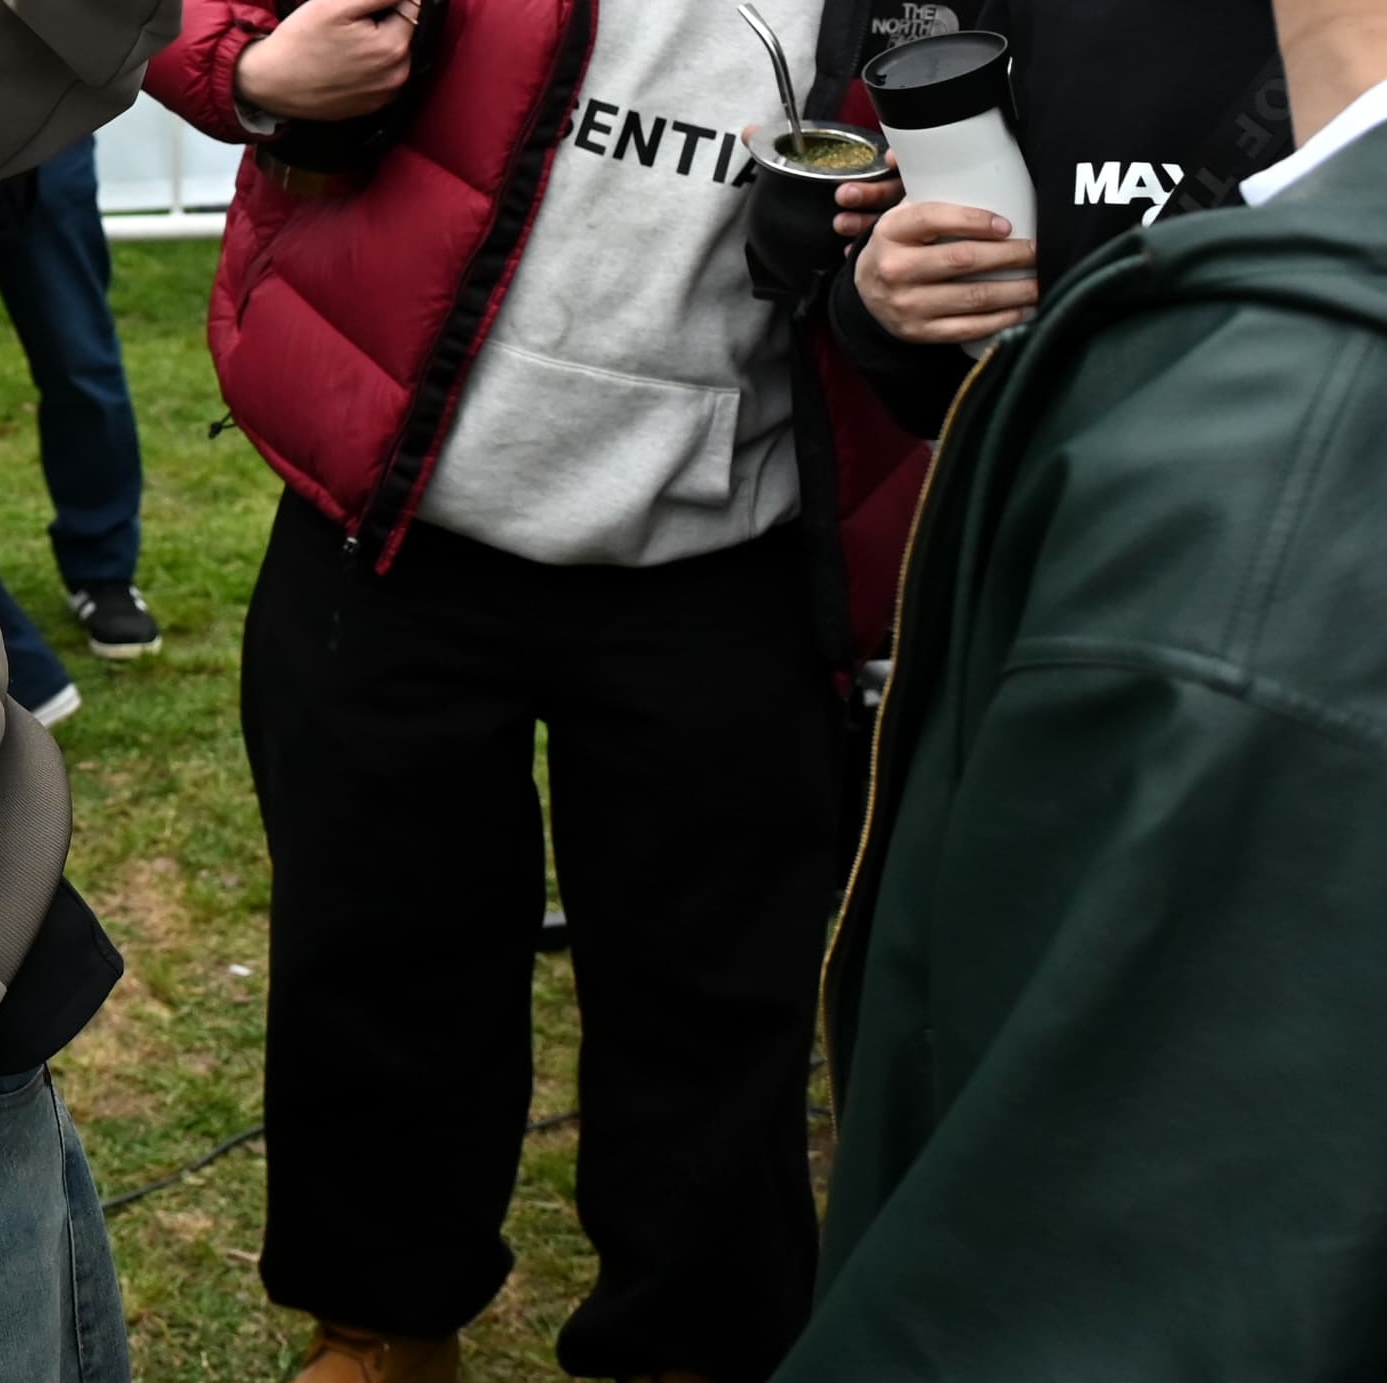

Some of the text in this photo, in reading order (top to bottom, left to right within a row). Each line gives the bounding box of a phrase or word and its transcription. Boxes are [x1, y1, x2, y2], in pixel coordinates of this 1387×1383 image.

[902, 3, 936, 20] THE
[872, 18, 933, 36] NORTH
[563, 98, 757, 188] ENTI
